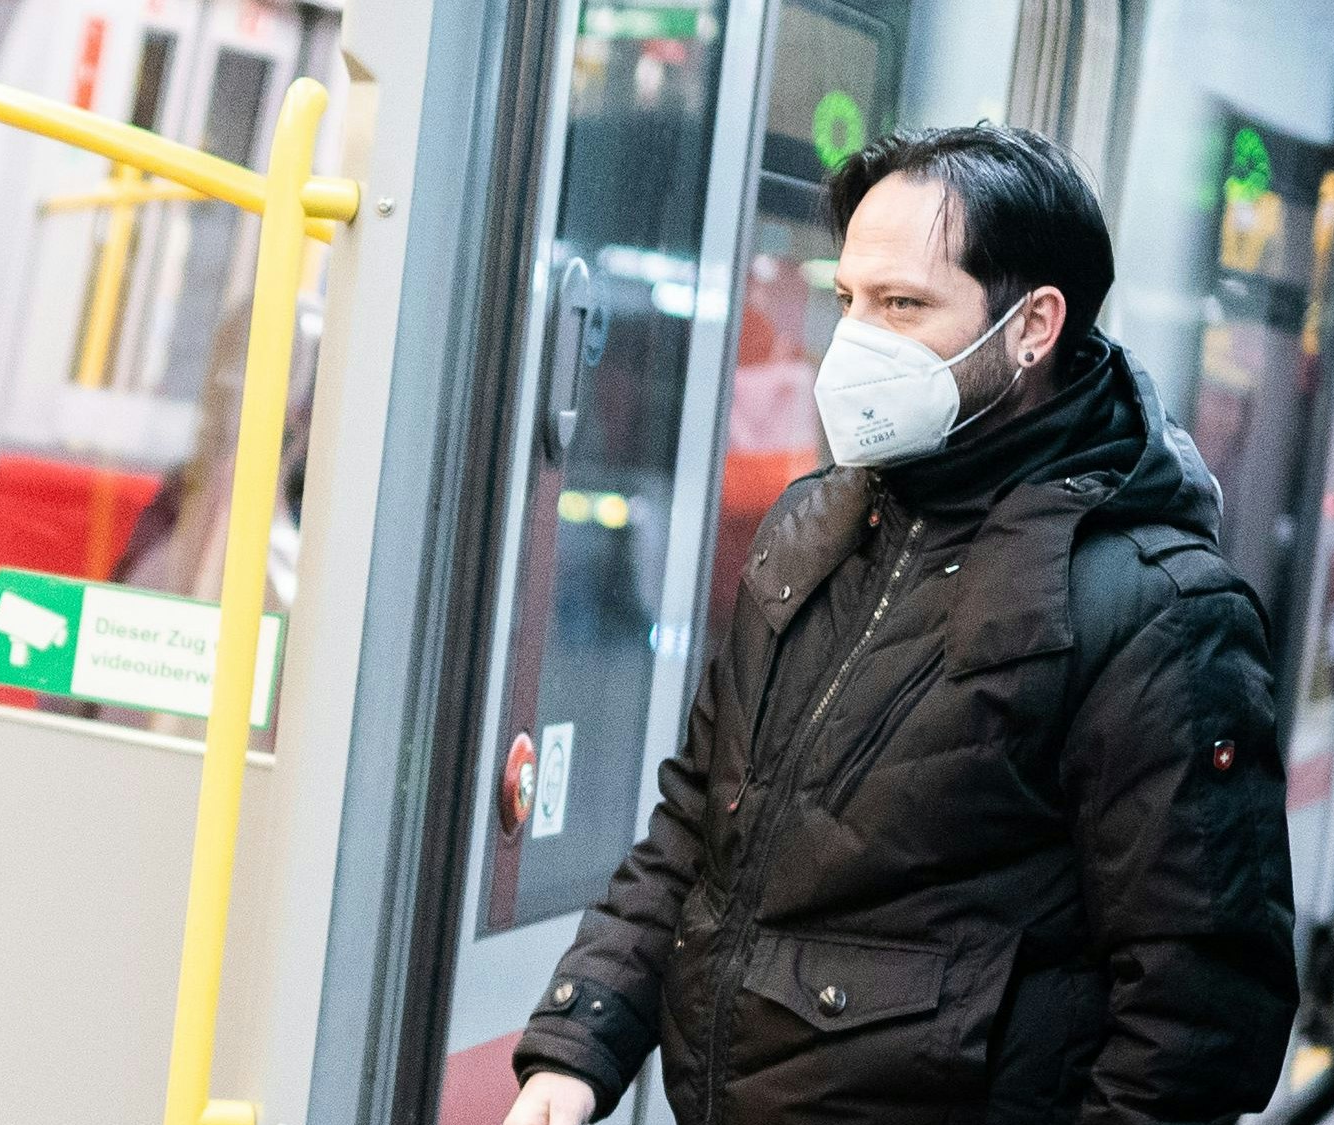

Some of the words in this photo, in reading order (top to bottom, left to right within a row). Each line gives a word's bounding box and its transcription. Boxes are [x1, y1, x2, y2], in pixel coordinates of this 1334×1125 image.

[95, 616, 160, 643] Dieser
[166, 629, 207, 656] Zug
[91, 650, 212, 684] videoüberw
